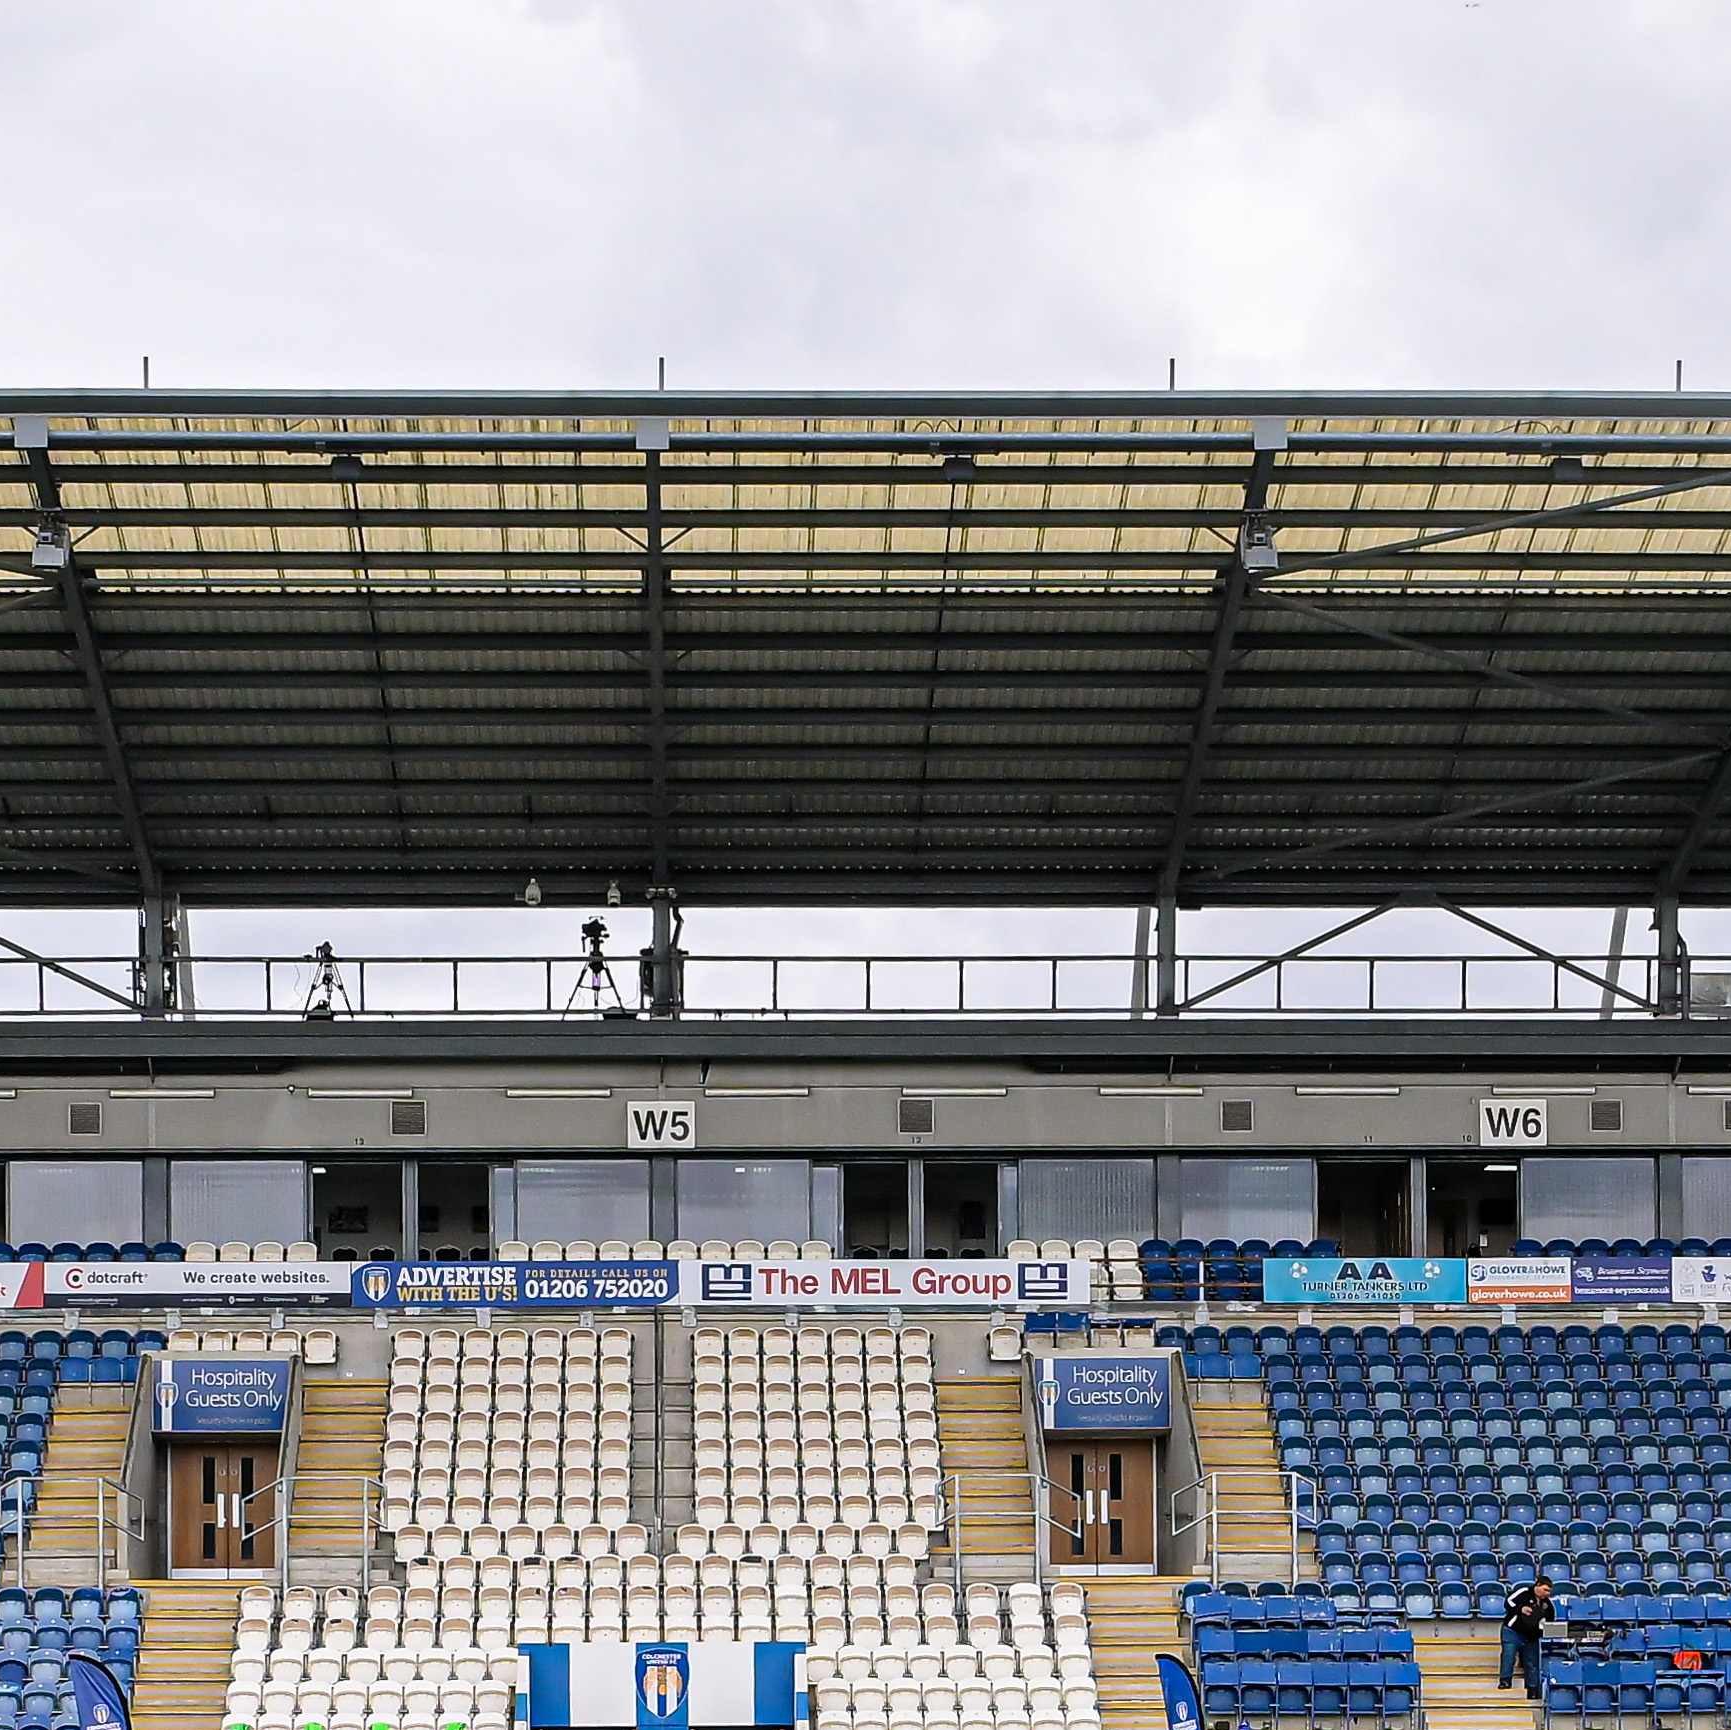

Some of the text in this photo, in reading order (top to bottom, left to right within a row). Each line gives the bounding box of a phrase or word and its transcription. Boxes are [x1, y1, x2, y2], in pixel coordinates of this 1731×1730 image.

[632, 1110, 690, 1141] W5
[1485, 1107, 1542, 1139] W6
[1364, 1135, 1372, 1143] 11
[183, 1272, 330, 1284] We create websites.
[397, 1267, 516, 1286] ADVERTISE
[525, 1269, 668, 1278] FOR DETAILS CALL US ON
[524, 1279, 668, 1298] 01206 752020
[758, 1267, 1011, 1300] The MEL Group
[1302, 1281, 1428, 1292] TURNER TANKERS LTD
[397, 1286, 443, 1302] WITH
[447, 1286, 482, 1302] THE
[1329, 1292, 1360, 1300] 01206
[1471, 1288, 1568, 1302] gloverhowe.co.uk
[191, 1368, 277, 1389] Hospitality
[1072, 1365, 1158, 1386] Hospitality
[185, 1390, 282, 1411] Guests Only
[1067, 1387, 1163, 1408] Guests Only
